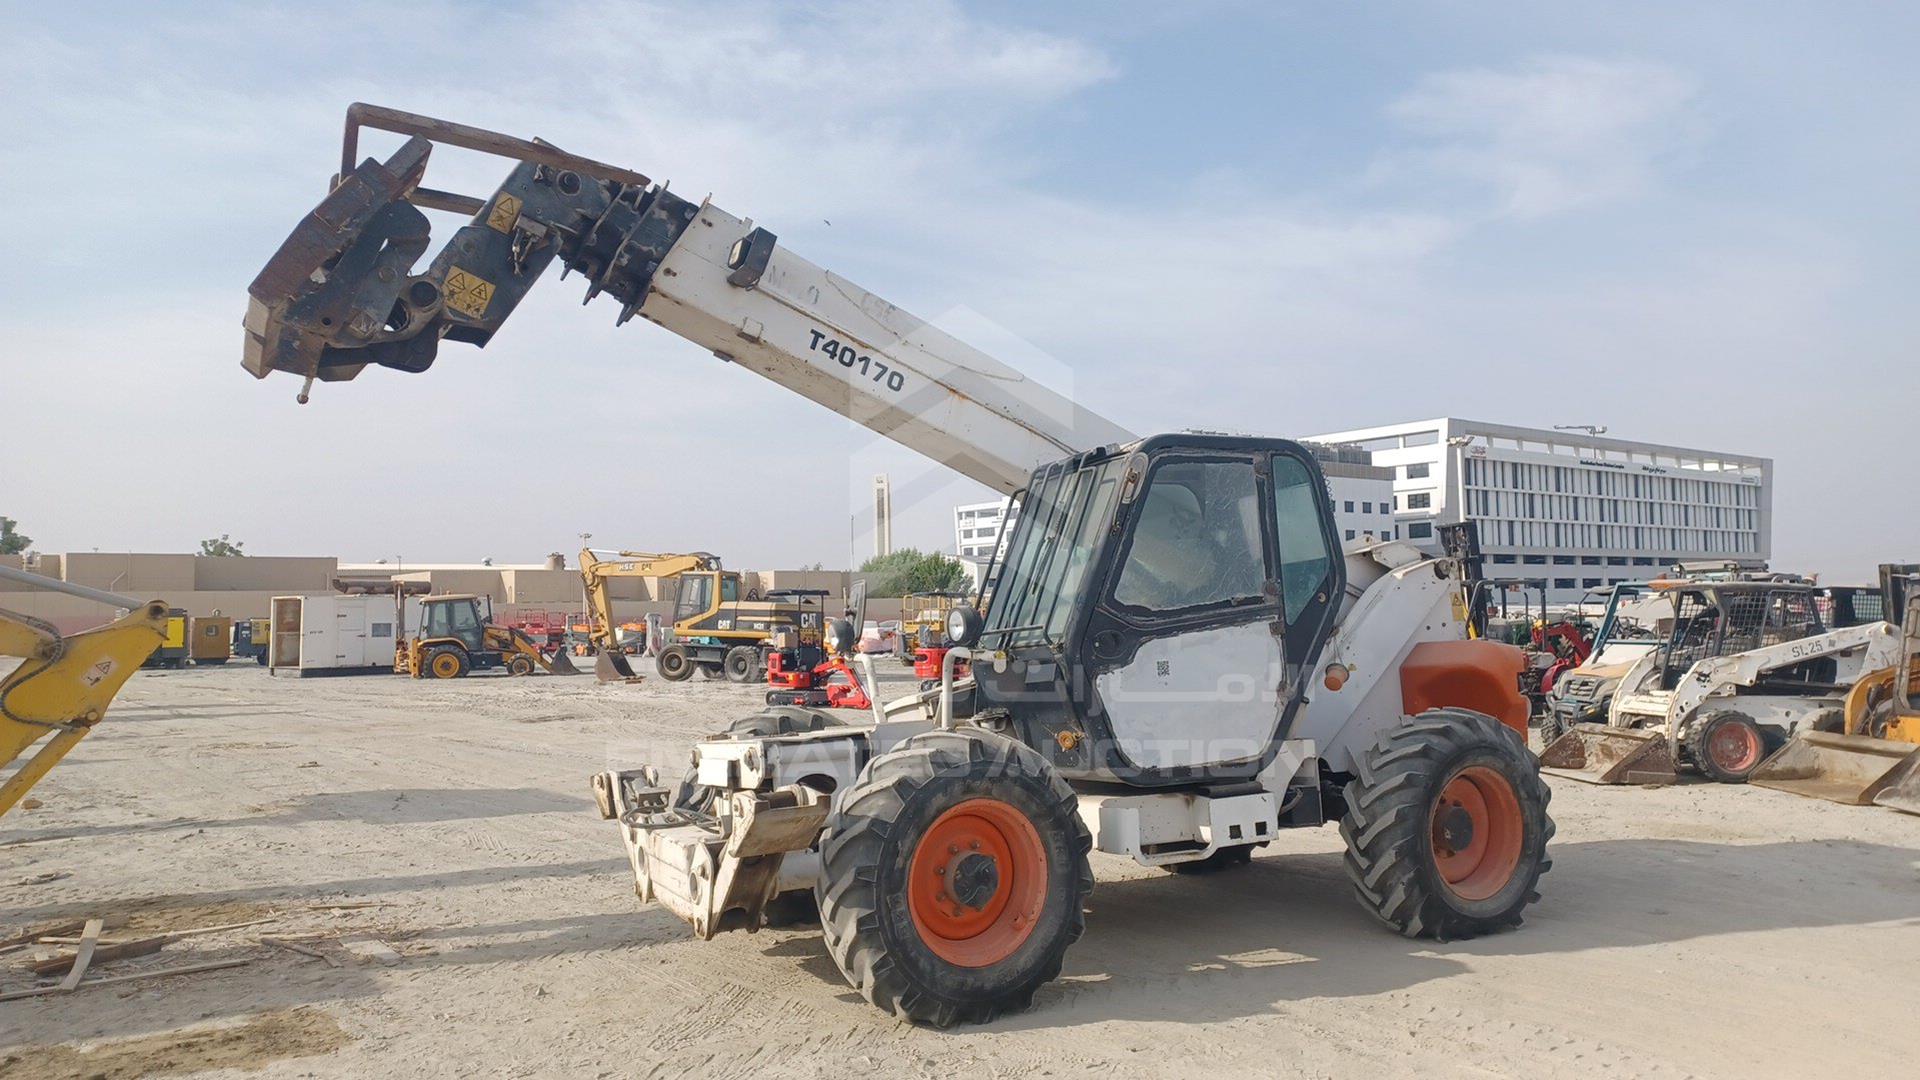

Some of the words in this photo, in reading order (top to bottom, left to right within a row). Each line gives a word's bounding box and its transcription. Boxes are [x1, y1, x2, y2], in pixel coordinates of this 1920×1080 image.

[809, 328, 905, 392] T40170
[717, 620, 731, 630] CAT
[801, 613, 817, 629] CAT
